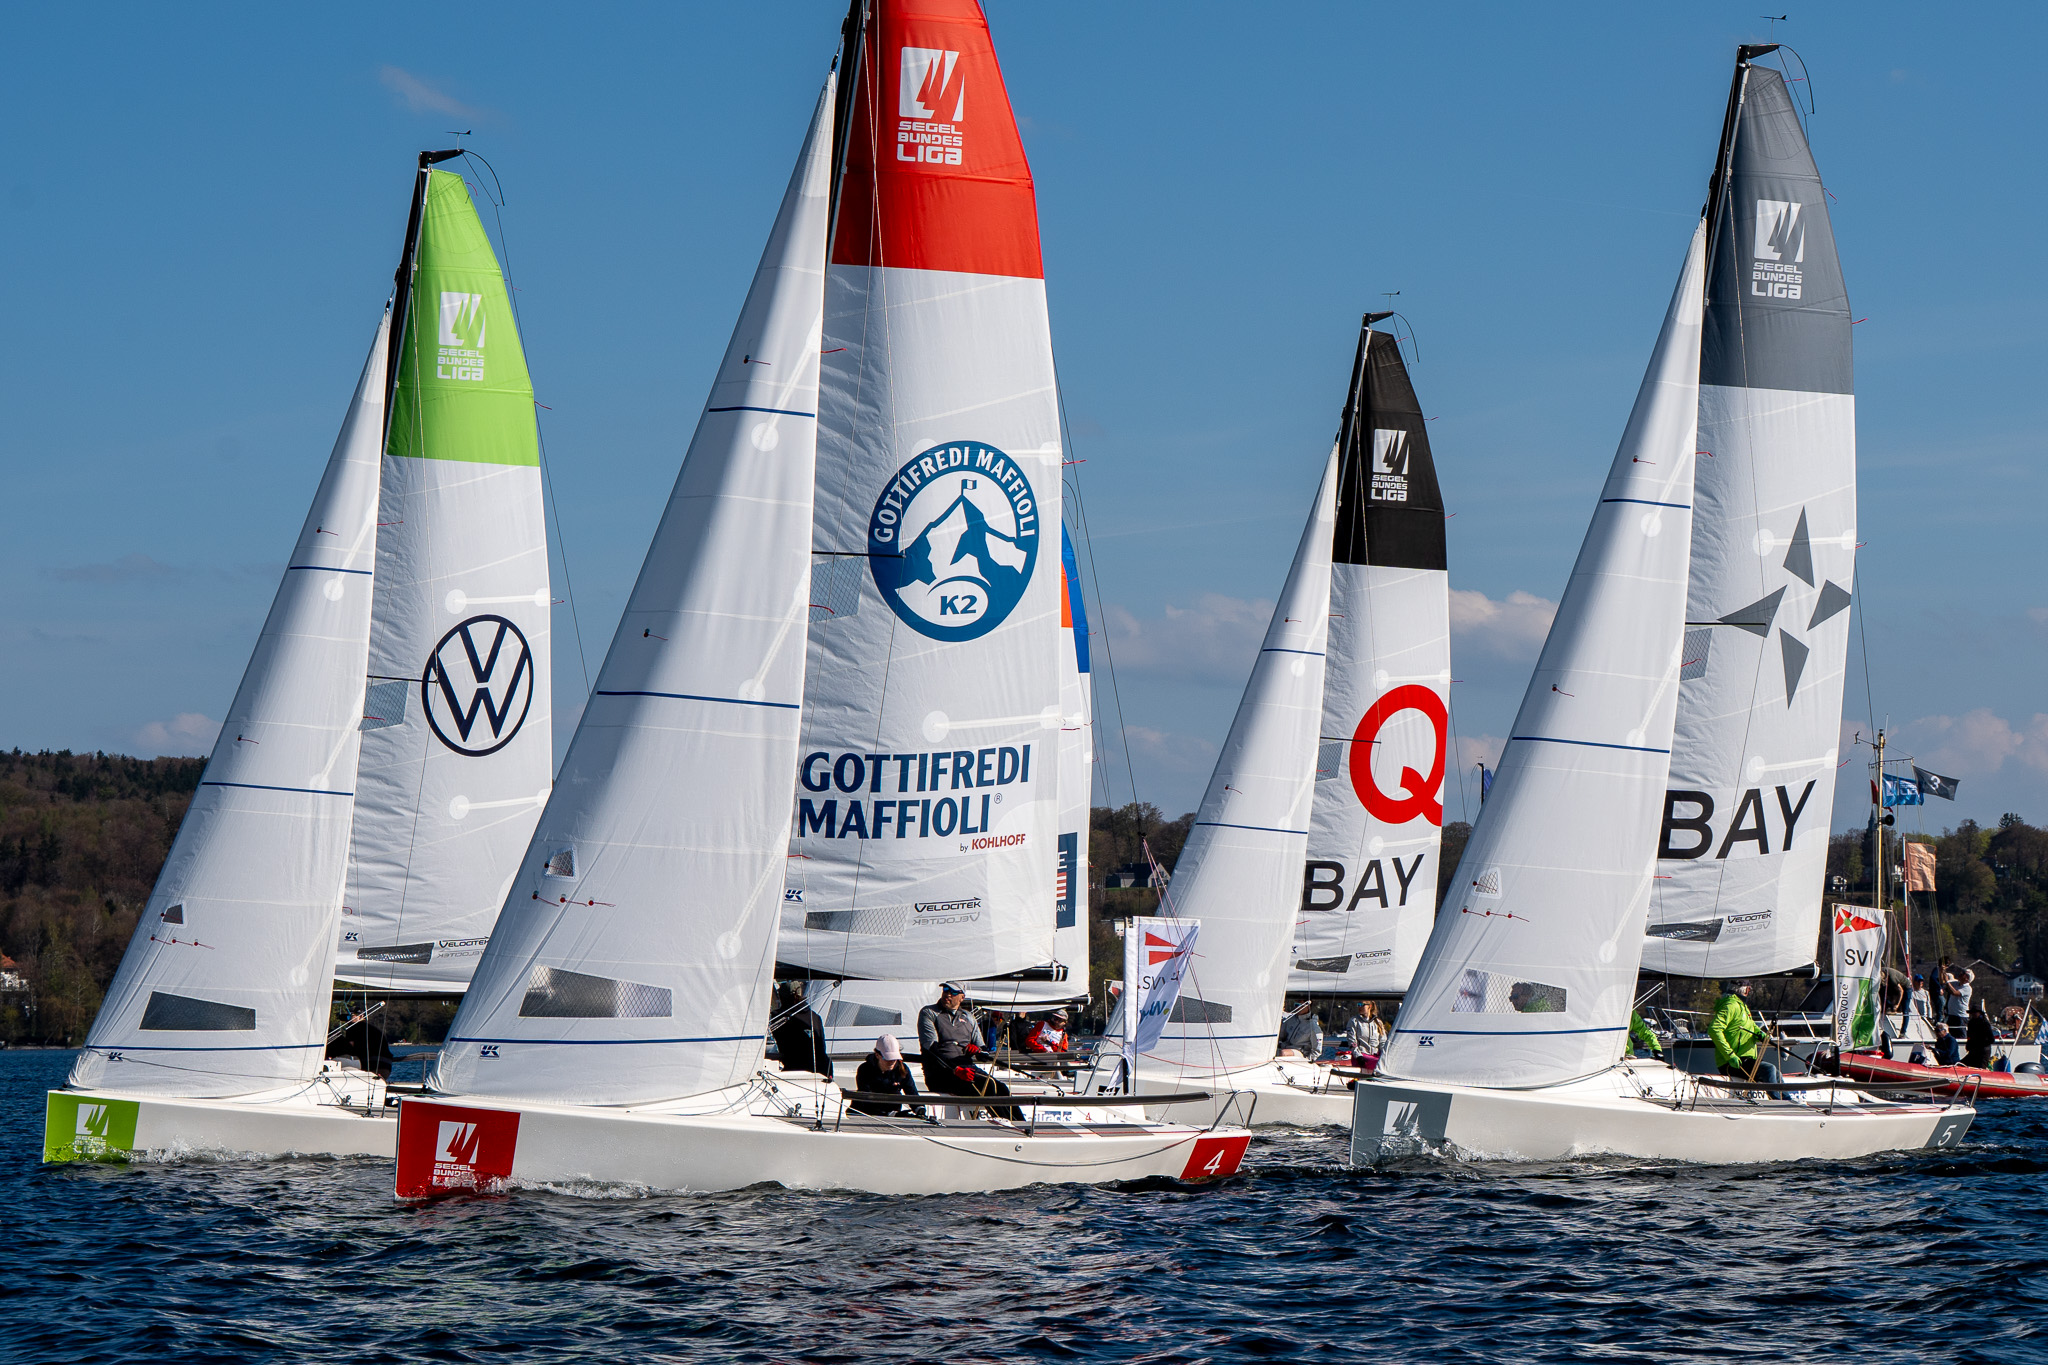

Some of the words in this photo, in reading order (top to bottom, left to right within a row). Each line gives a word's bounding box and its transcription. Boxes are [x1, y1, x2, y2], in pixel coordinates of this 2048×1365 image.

[898, 120, 963, 135] SEGEL
[897, 131, 963, 147] BUNDES
[1752, 261, 1803, 275] SEGEL
[1752, 270, 1803, 284] BUNDES
[437, 347, 485, 358] SEGEL
[437, 355, 485, 367] BUNDES
[1371, 474, 1408, 483] SEGEL
[1371, 481, 1408, 490] BUNDES
[873, 446, 970, 543] GOTTIFREDI
[975, 448, 1036, 537] MAFFIOLI
[939, 594, 978, 616] K2
[1349, 684, 1449, 827] Q
[800, 744, 1031, 793] GOTTIFREDI
[1930, 775, 1941, 791] 3
[1657, 778, 1818, 860] BAY
[960, 843, 969, 853] by
[971, 833, 1027, 850] KOHLHOFF
[1300, 853, 1425, 912] BAY
[914, 899, 981, 913] VELOCITEK
[1727, 912, 1772, 924] VELOCITEK
[1355, 951, 1392, 960] VELOCITEK
[1844, 948, 1874, 967] SV
[1735, 1090, 1766, 1099] wdotv
[1085, 1112, 1092, 1123] 4
[1937, 1124, 1958, 1147] 5
[434, 1163, 475, 1172] SEGEL
[1203, 1149, 1225, 1175] 4
